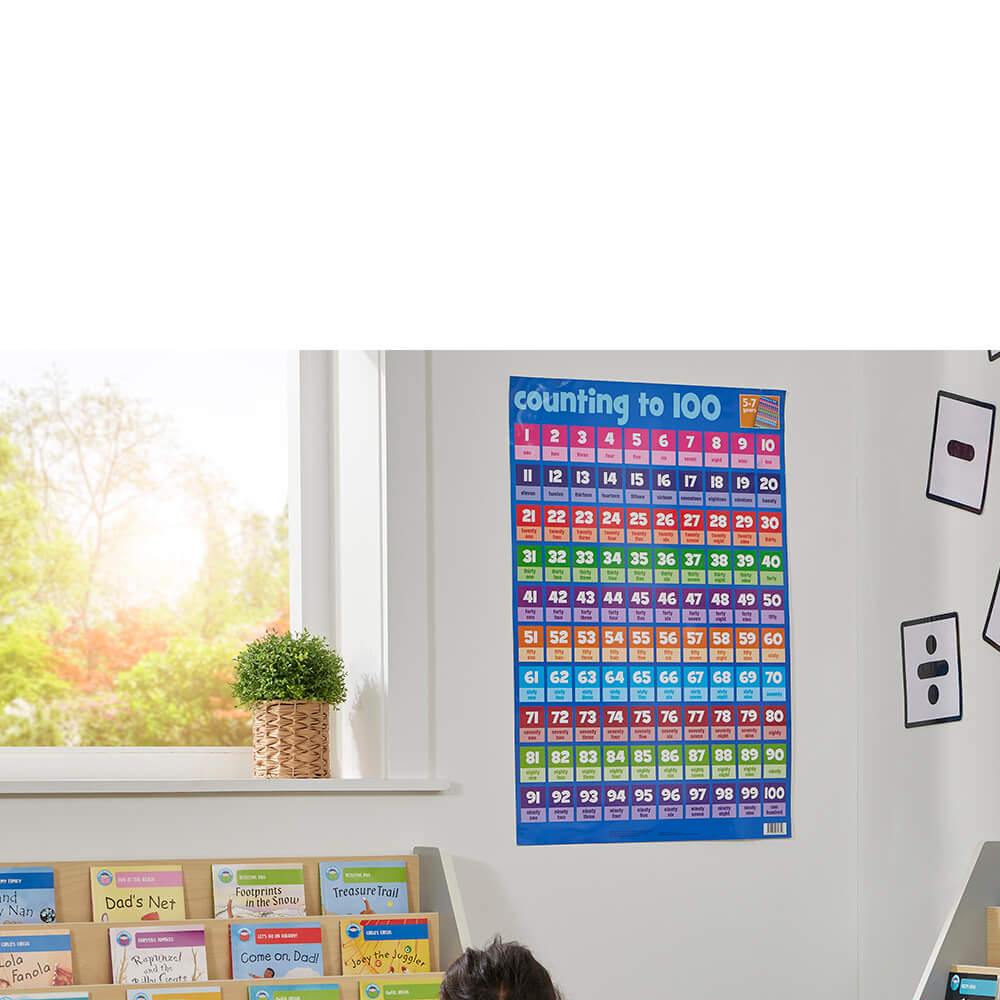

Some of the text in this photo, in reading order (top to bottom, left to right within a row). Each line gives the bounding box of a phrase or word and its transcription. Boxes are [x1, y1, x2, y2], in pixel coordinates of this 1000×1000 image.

[514, 388, 721, 425] counting to 100
[523, 590, 650, 605] 41 42 43 44 45
[526, 787, 785, 804] 91 92 93 94 95 96 97 98 99 100
[235, 886, 282, 897] Footprints
[332, 885, 399, 898] Treasure Trail
[105, 896, 176, 910] Dad's Net
[245, 896, 299, 907] in the Snow
[9, 904, 33, 917] Nan
[131, 952, 182, 966] Rapunzel
[240, 950, 320, 964] Come on, Dad!
[351, 949, 425, 969] Joey the Juggler
[11, 962, 51, 983] Fanola
[144, 964, 158, 974] and
